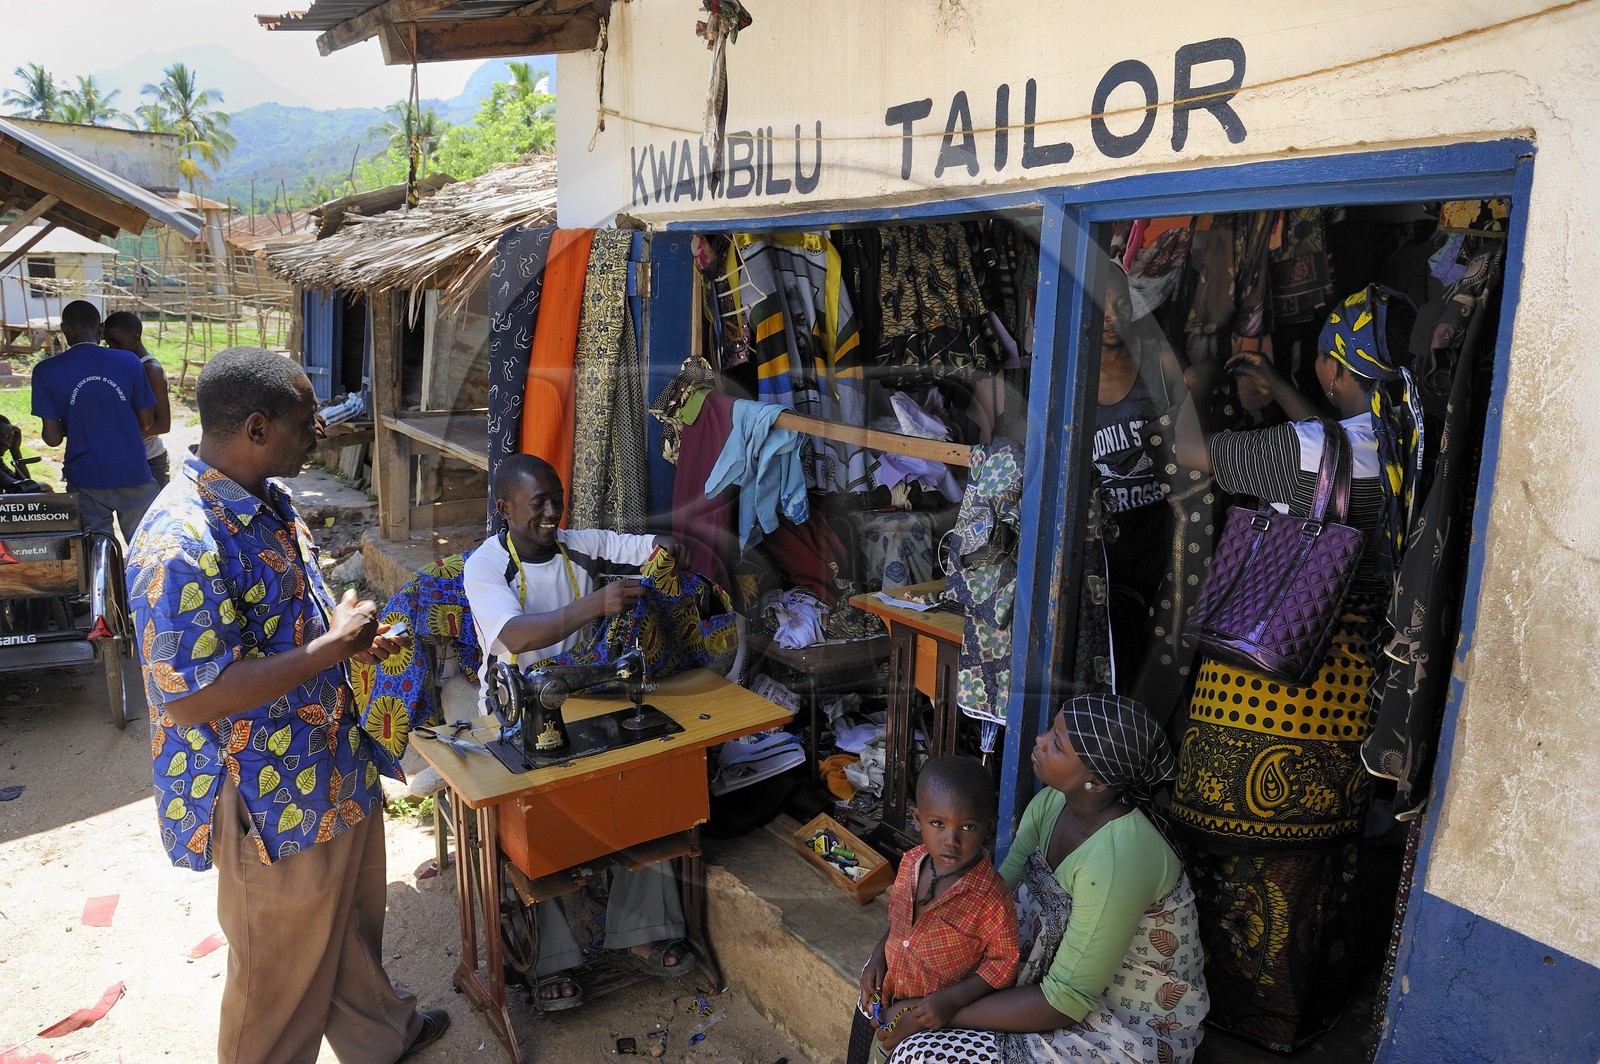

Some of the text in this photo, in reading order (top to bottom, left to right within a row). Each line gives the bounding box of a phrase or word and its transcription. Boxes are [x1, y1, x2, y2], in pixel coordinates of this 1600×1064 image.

[885, 37, 1247, 180] TAILOR
[70, 387, 79, 405] QUALITY
[77, 376, 101, 388] EDUCATION
[107, 380, 117, 388] OUR
[116, 386, 126, 401] TARGET
[28, 503, 40, 511] BY
[12, 513, 69, 522] BALKISSOON
